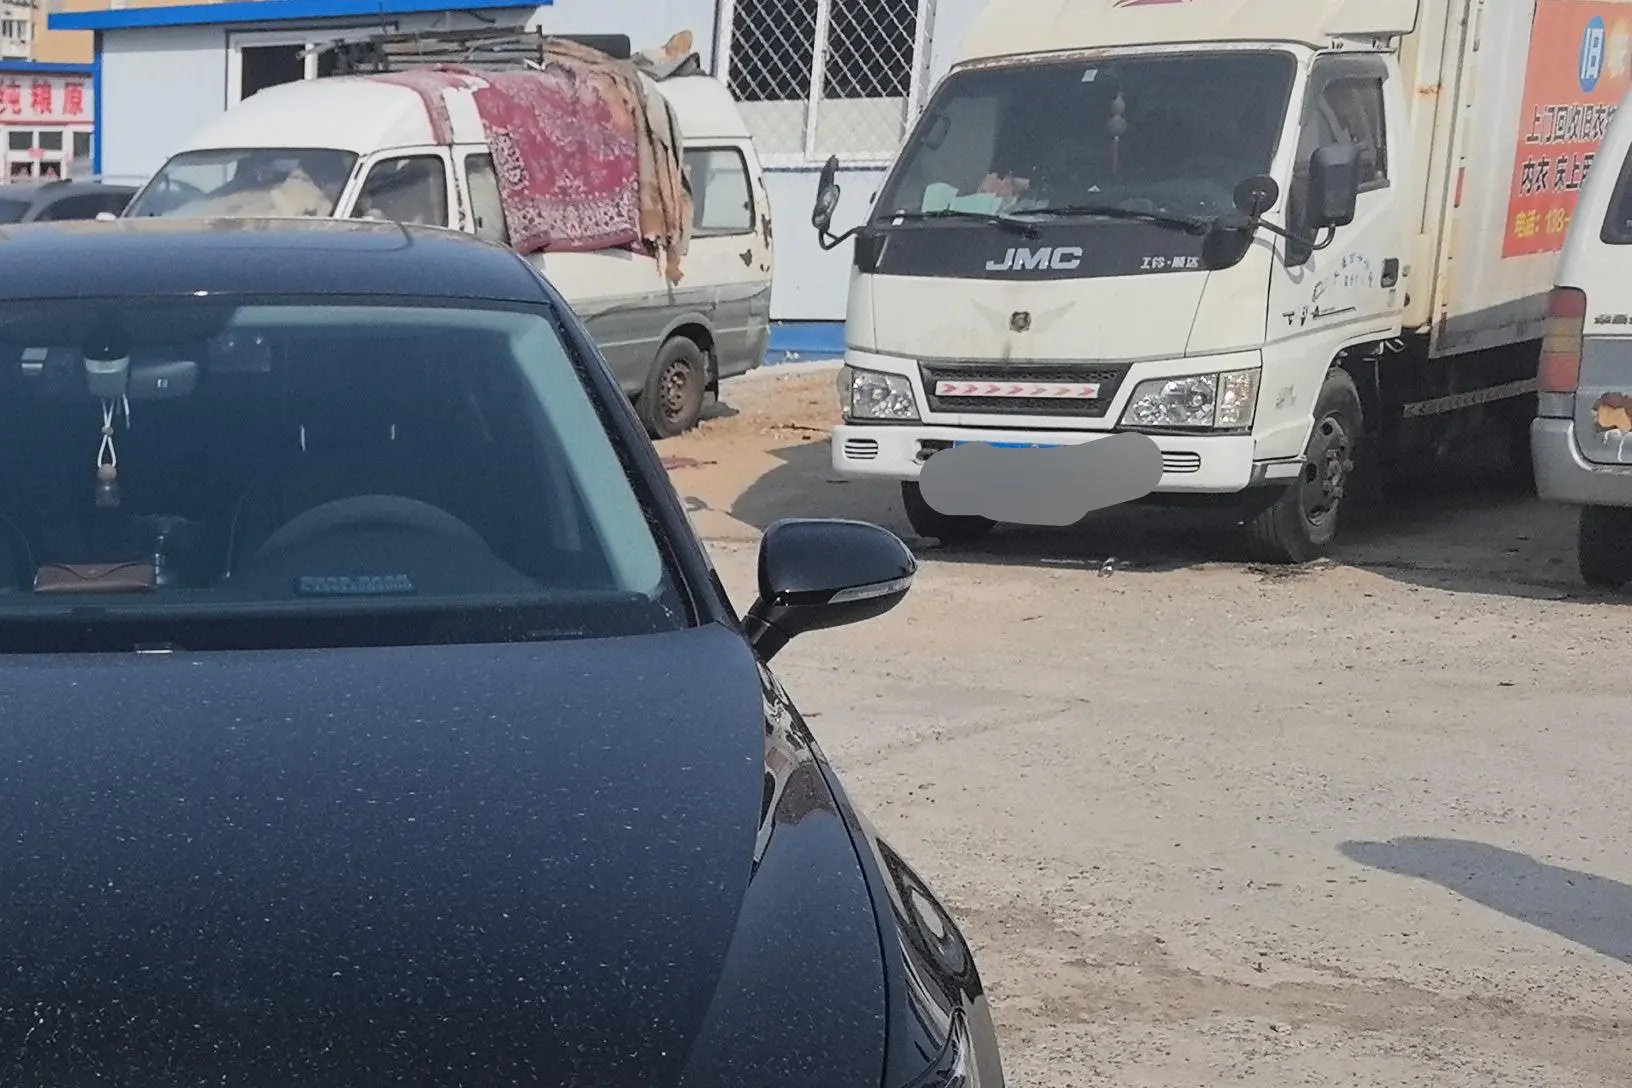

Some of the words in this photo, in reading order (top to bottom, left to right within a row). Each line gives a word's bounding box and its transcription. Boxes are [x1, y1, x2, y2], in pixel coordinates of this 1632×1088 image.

[0, 79, 83, 116] 纯粮原
[1519, 155, 1550, 194] 内衣
[985, 246, 1083, 271] JMC
